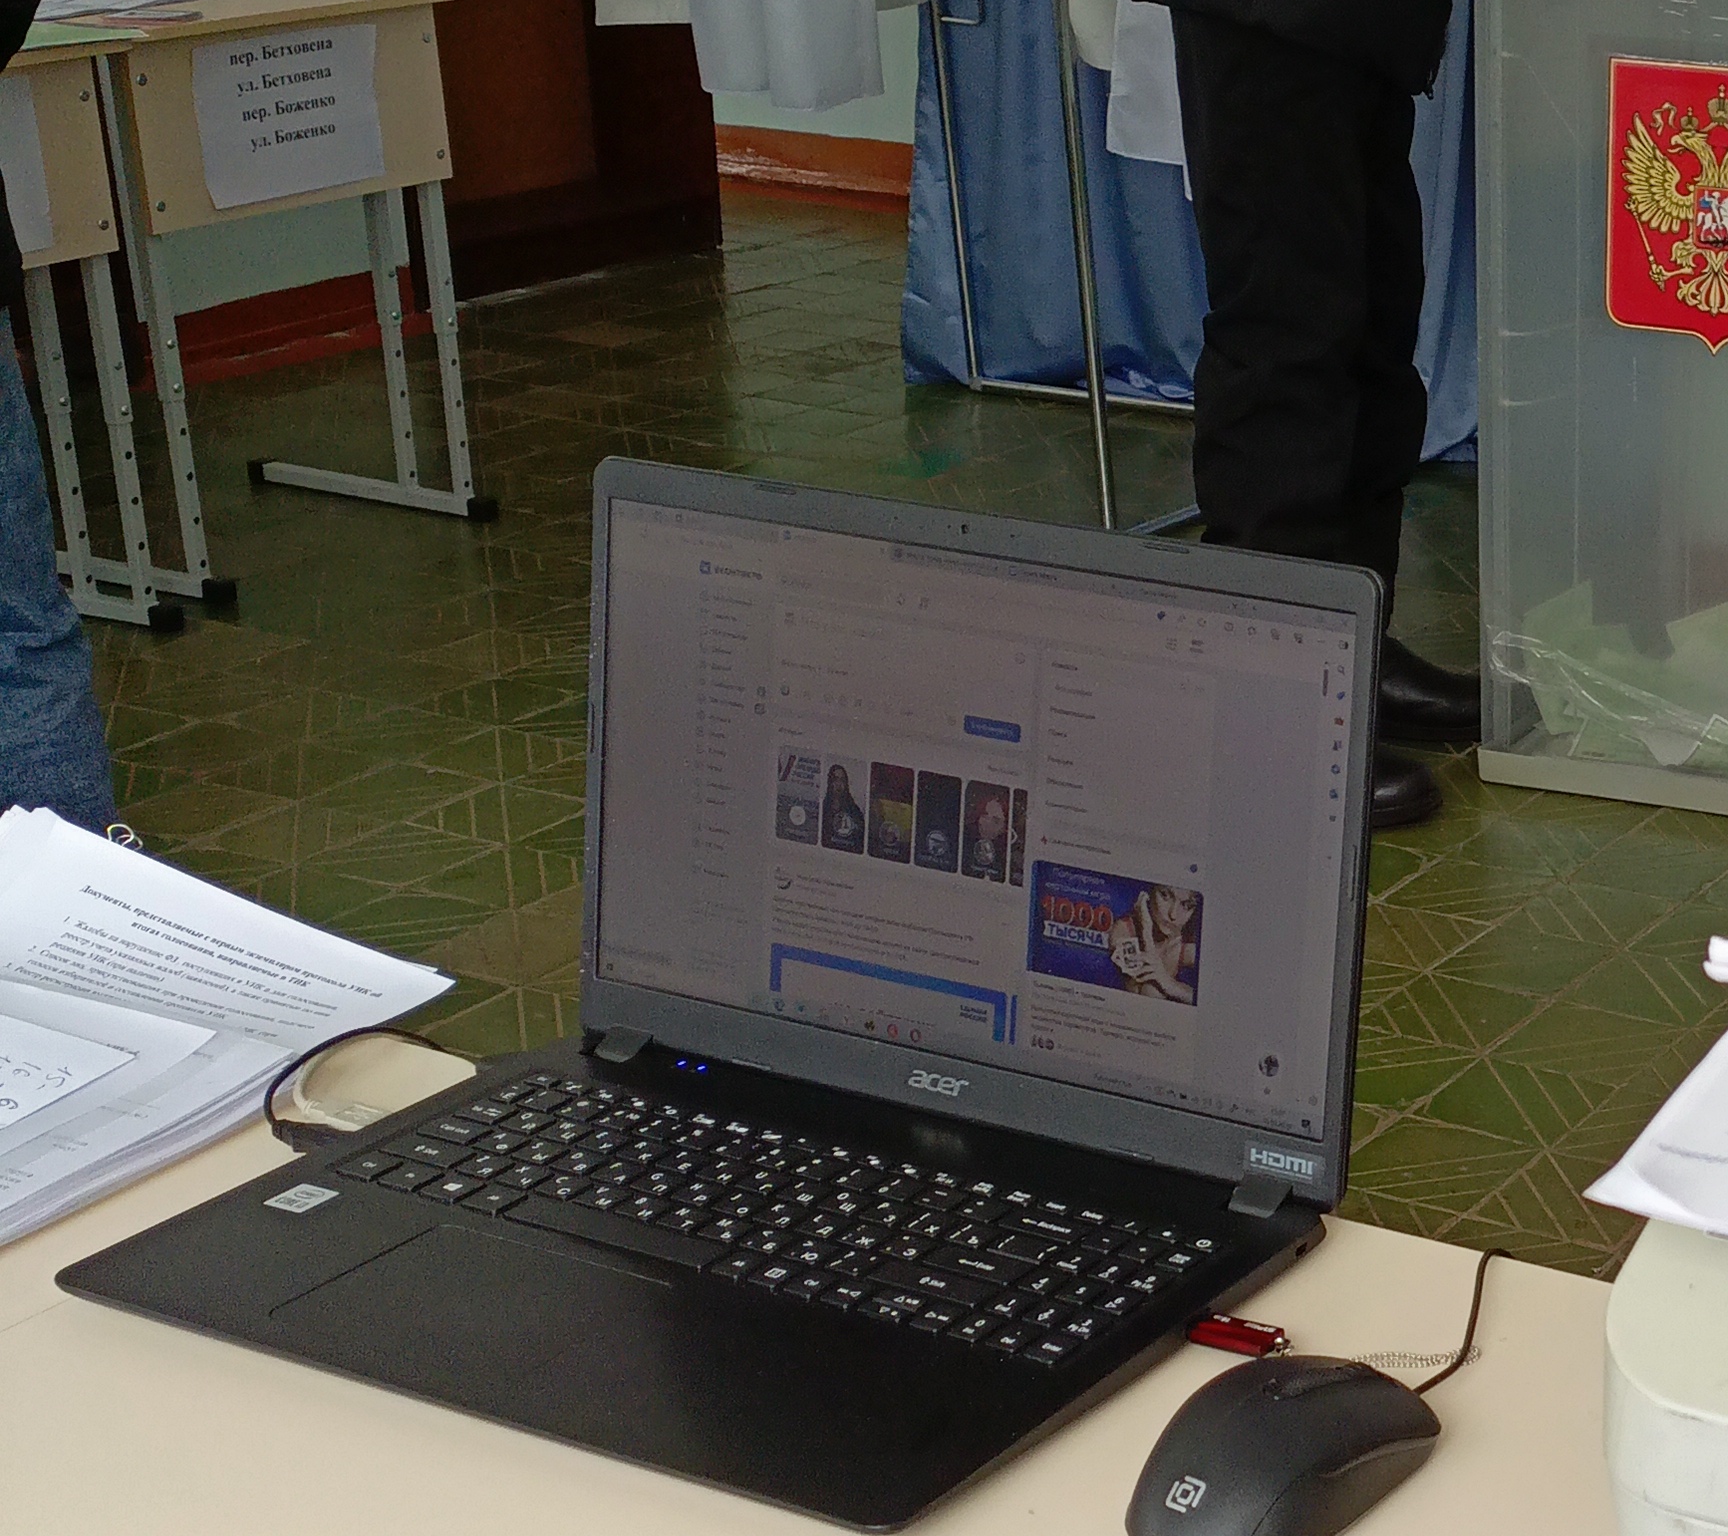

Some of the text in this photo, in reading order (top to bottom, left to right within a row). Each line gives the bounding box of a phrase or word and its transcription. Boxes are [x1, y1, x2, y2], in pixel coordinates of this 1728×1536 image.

[229, 37, 333, 67] пер. Бетховена
[236, 65, 332, 97] ул. Бетховена
[241, 93, 336, 124] пер. Боженко
[250, 121, 336, 152] ул. Боженко
[80, 885, 132, 913] Документы,
[1041, 894, 1114, 932] 1000
[1047, 922, 1104, 946] ТЫСЯЧА
[908, 1069, 970, 1098] acer
[1250, 1147, 1314, 1176] HDMI
